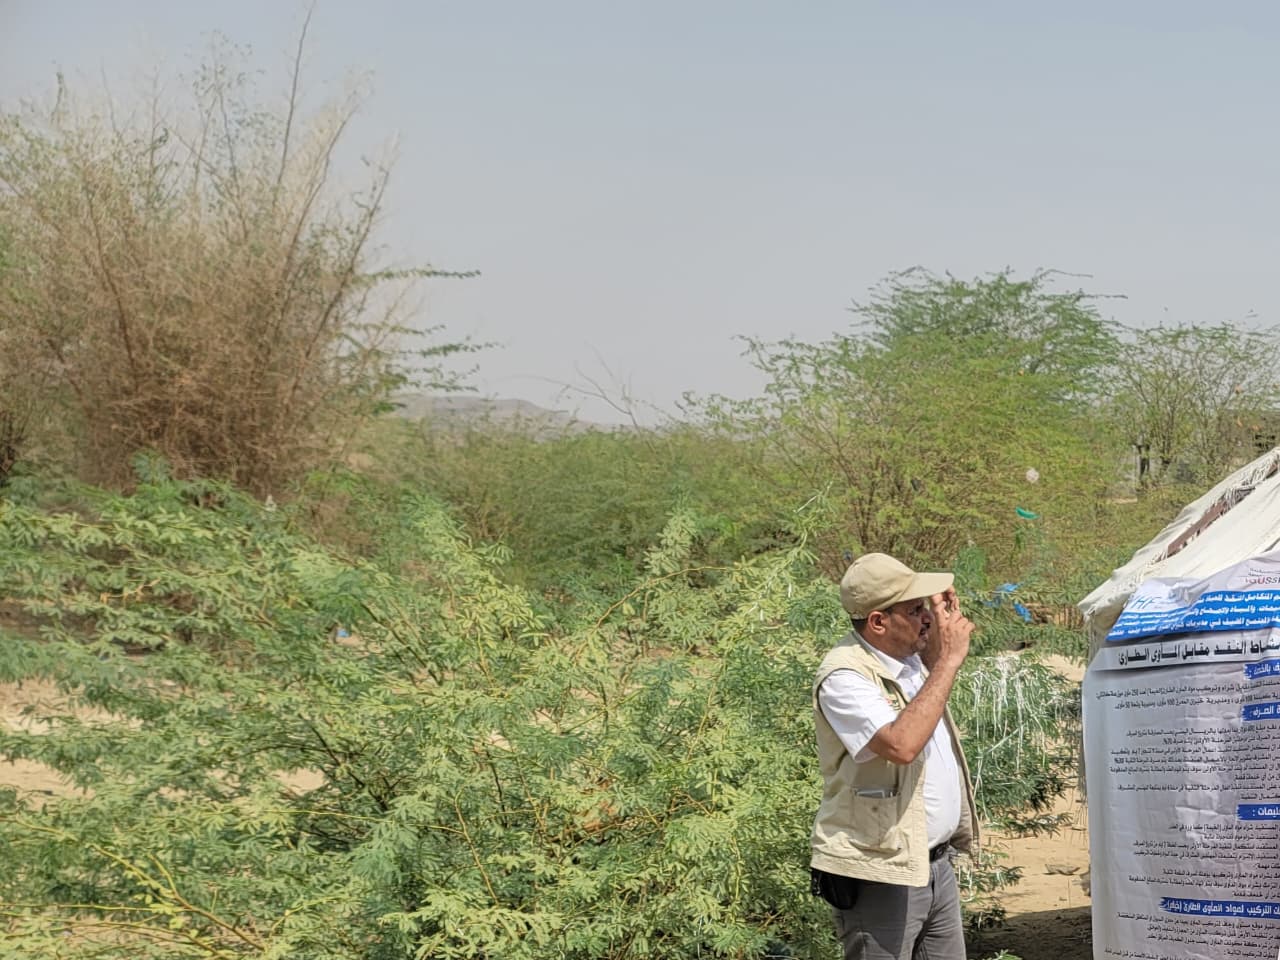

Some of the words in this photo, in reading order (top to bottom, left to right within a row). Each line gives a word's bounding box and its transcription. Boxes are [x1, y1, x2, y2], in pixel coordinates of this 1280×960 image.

[1182, 643, 1210, 660] مقابل
[1214, 640, 1246, 654] النقد
[1225, 904, 1244, 915] لمواد
[1246, 904, 1271, 916] التركيب
